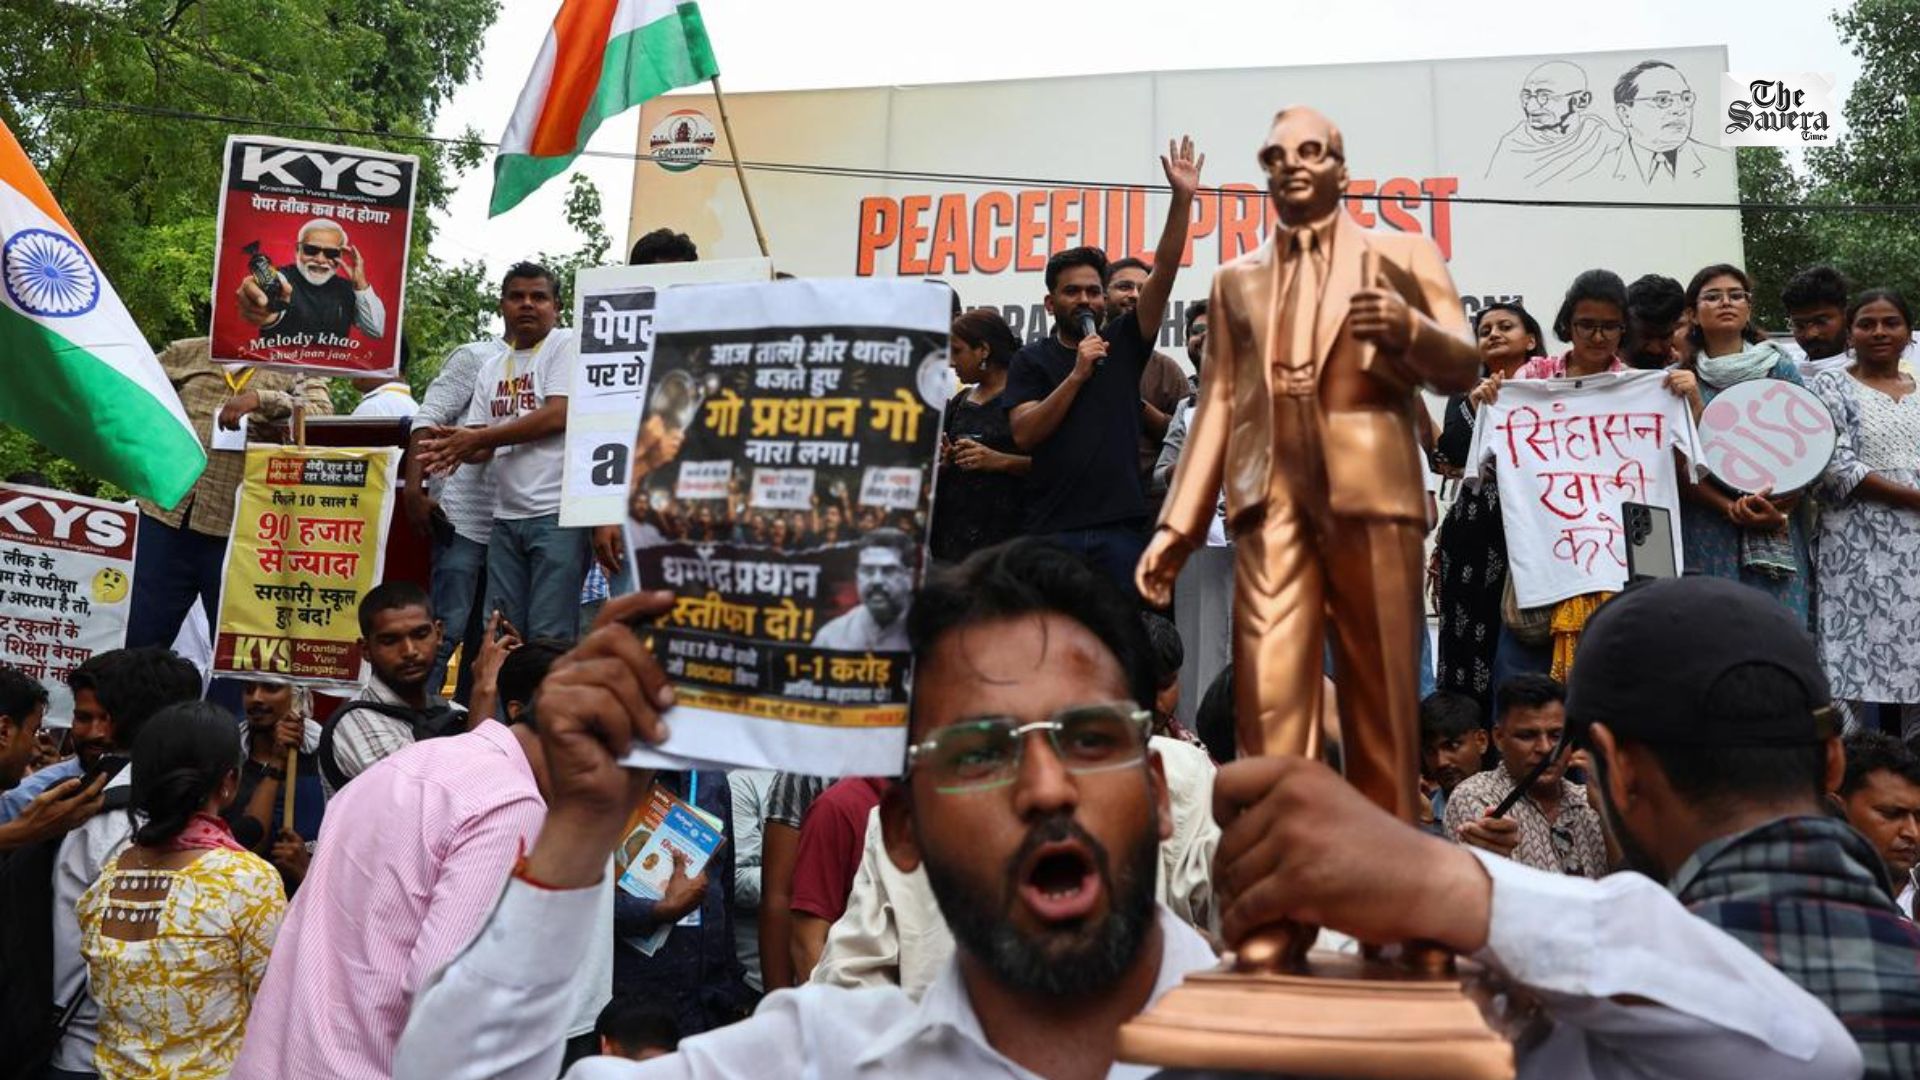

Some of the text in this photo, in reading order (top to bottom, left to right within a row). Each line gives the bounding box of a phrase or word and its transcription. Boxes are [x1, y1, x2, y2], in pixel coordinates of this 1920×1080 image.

[242, 146, 401, 197] KYS
[252, 193, 277, 211] पेपर
[279, 197, 309, 214] लीक
[311, 203, 336, 217] कब
[856, 177, 1457, 276] PEACEFUL PREST
[250, 332, 360, 351] Melody khao
[710, 335, 913, 367] आज ताली और थाली
[586, 363, 618, 387] पर
[755, 364, 842, 397] बजते हुए
[704, 388, 924, 442] गो प्रधान गो
[1496, 403, 1664, 468] सिंहासन
[745, 440, 794, 465] नारा
[300, 494, 315, 507] 10
[319, 496, 347, 507] साल
[350, 493, 359, 507] में
[1536, 461, 1656, 520] खाली
[0, 531, 36, 543] rantikari
[258, 512, 365, 545] 90 हजार
[3, 548, 55, 570] लीक के
[257, 541, 359, 579] से ज्यादा
[18, 569, 32, 587] से
[35, 573, 78, 593] परीक्षा
[735, 561, 821, 597] प्रधान
[8, 591, 57, 610] अपराध
[58, 590, 69, 613] है
[318, 588, 357, 611] स्कूल
[297, 602, 332, 627] बंद!
[654, 591, 814, 640] स्तीफा दो!
[14, 616, 61, 640] स्कूलों
[64, 619, 81, 639] के
[4, 634, 49, 660] शिक्षा
[232, 636, 291, 672] KYS
